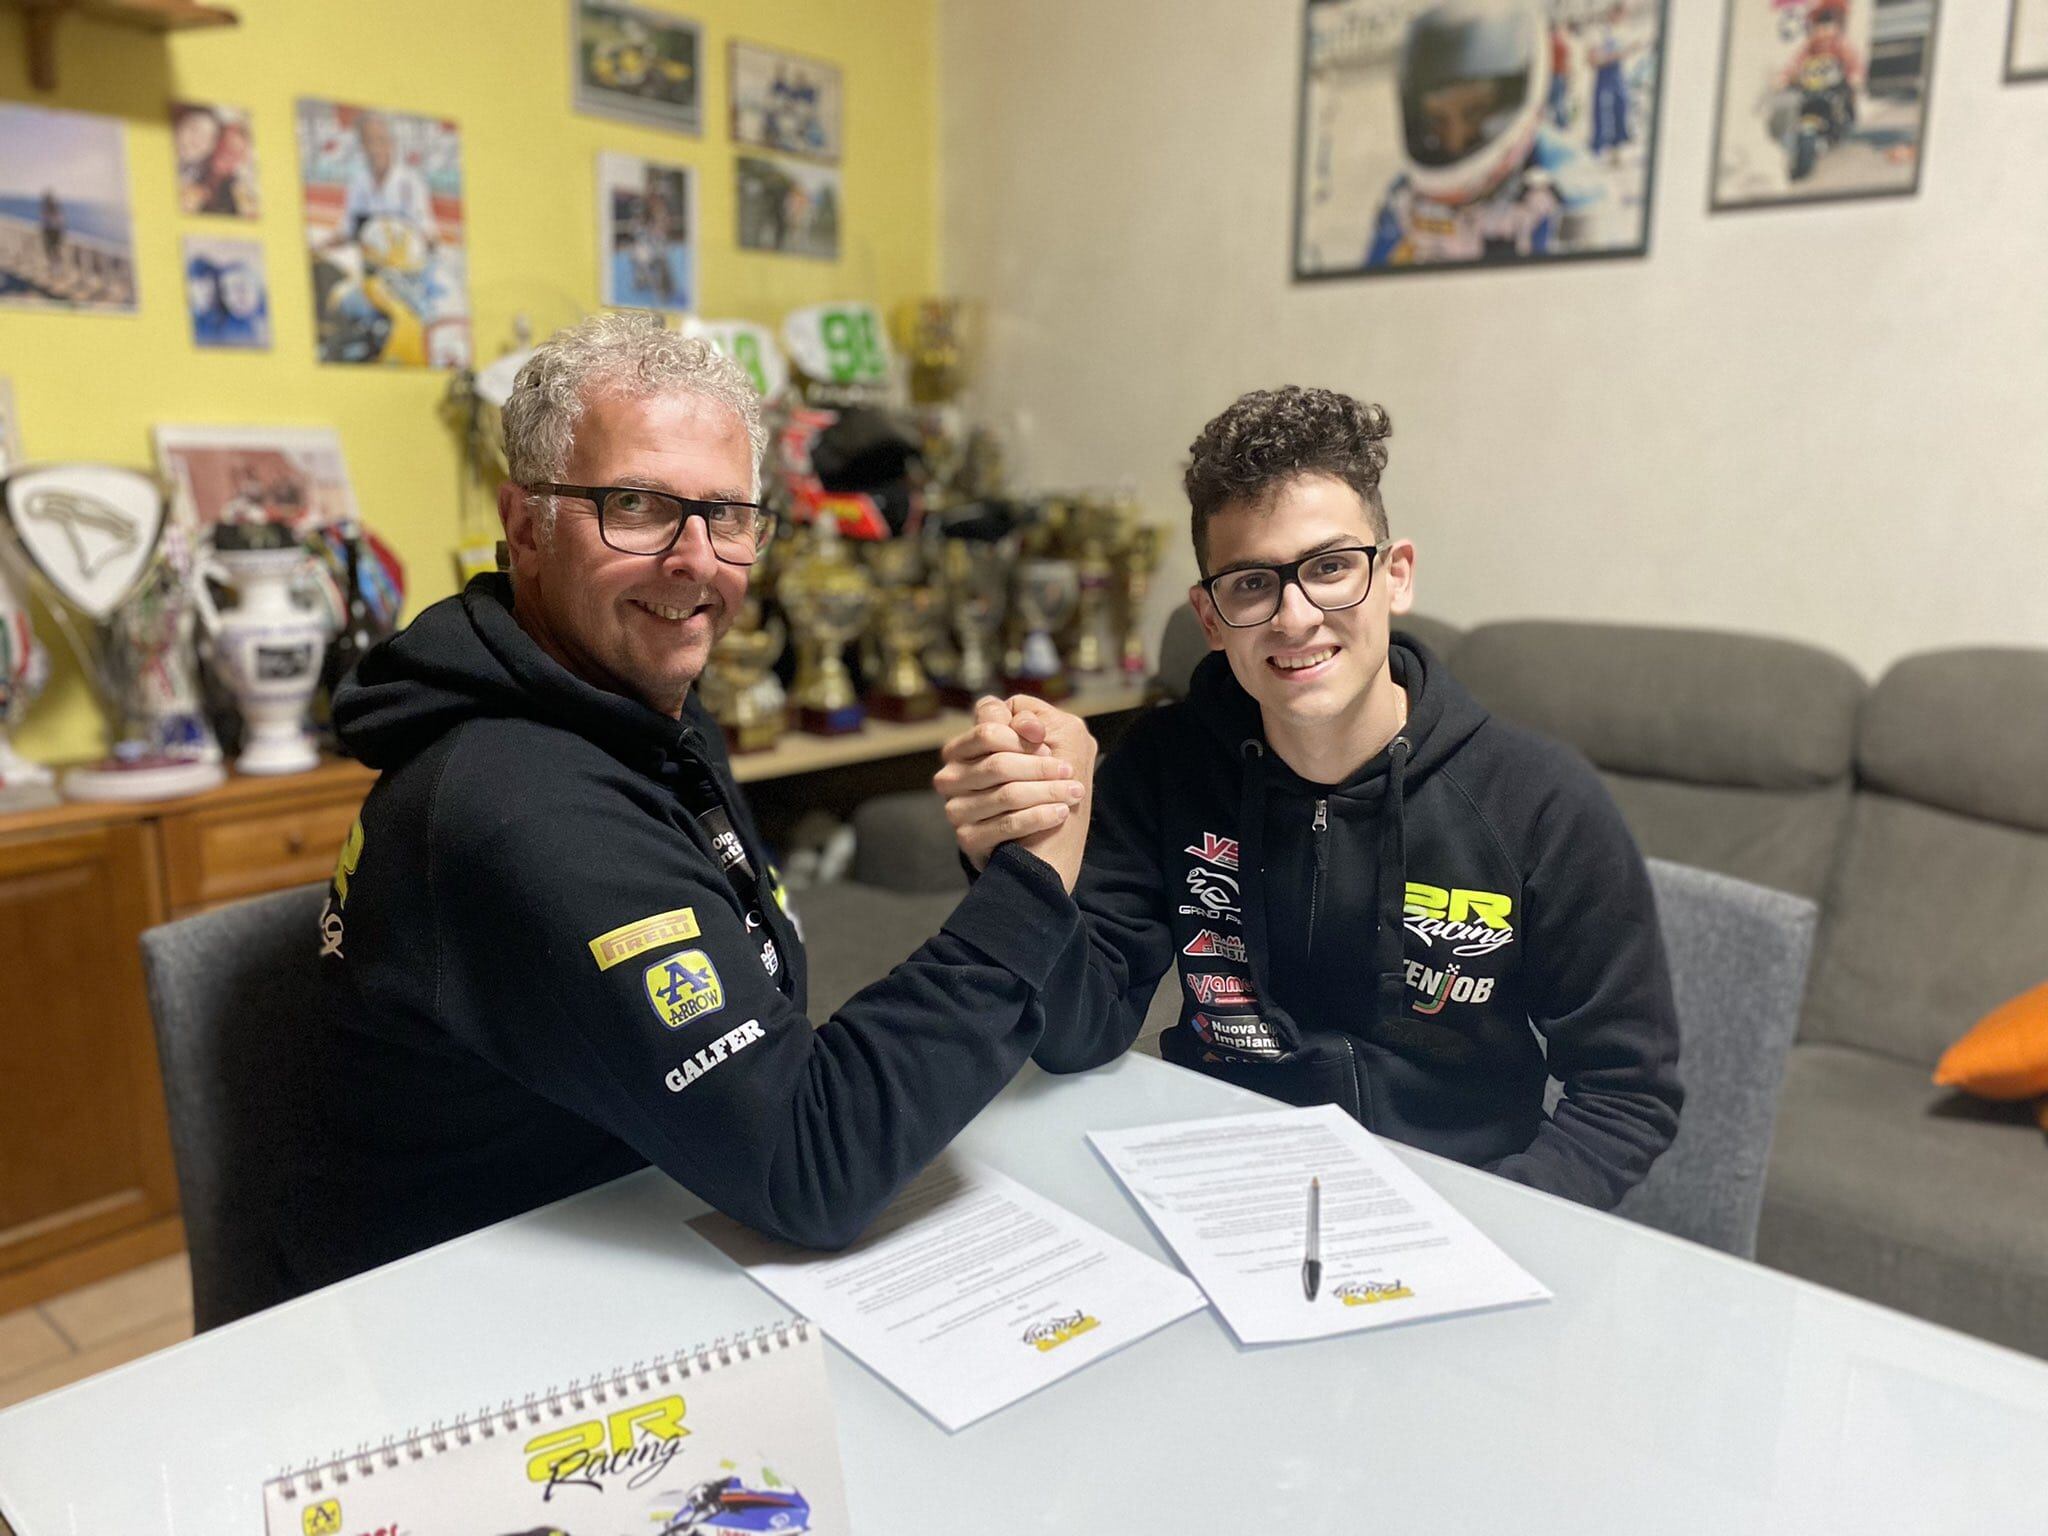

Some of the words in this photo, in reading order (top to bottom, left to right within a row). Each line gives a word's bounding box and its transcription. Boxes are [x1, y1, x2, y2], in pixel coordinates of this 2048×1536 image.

[601, 914, 692, 961] PIRELLI
[669, 989, 718, 1025] ARROW
[1211, 1020, 1257, 1035] Nuova
[664, 1019, 766, 1093] GALFER
[523, 1394, 692, 1484] 2R
[543, 1428, 684, 1503] Racing
